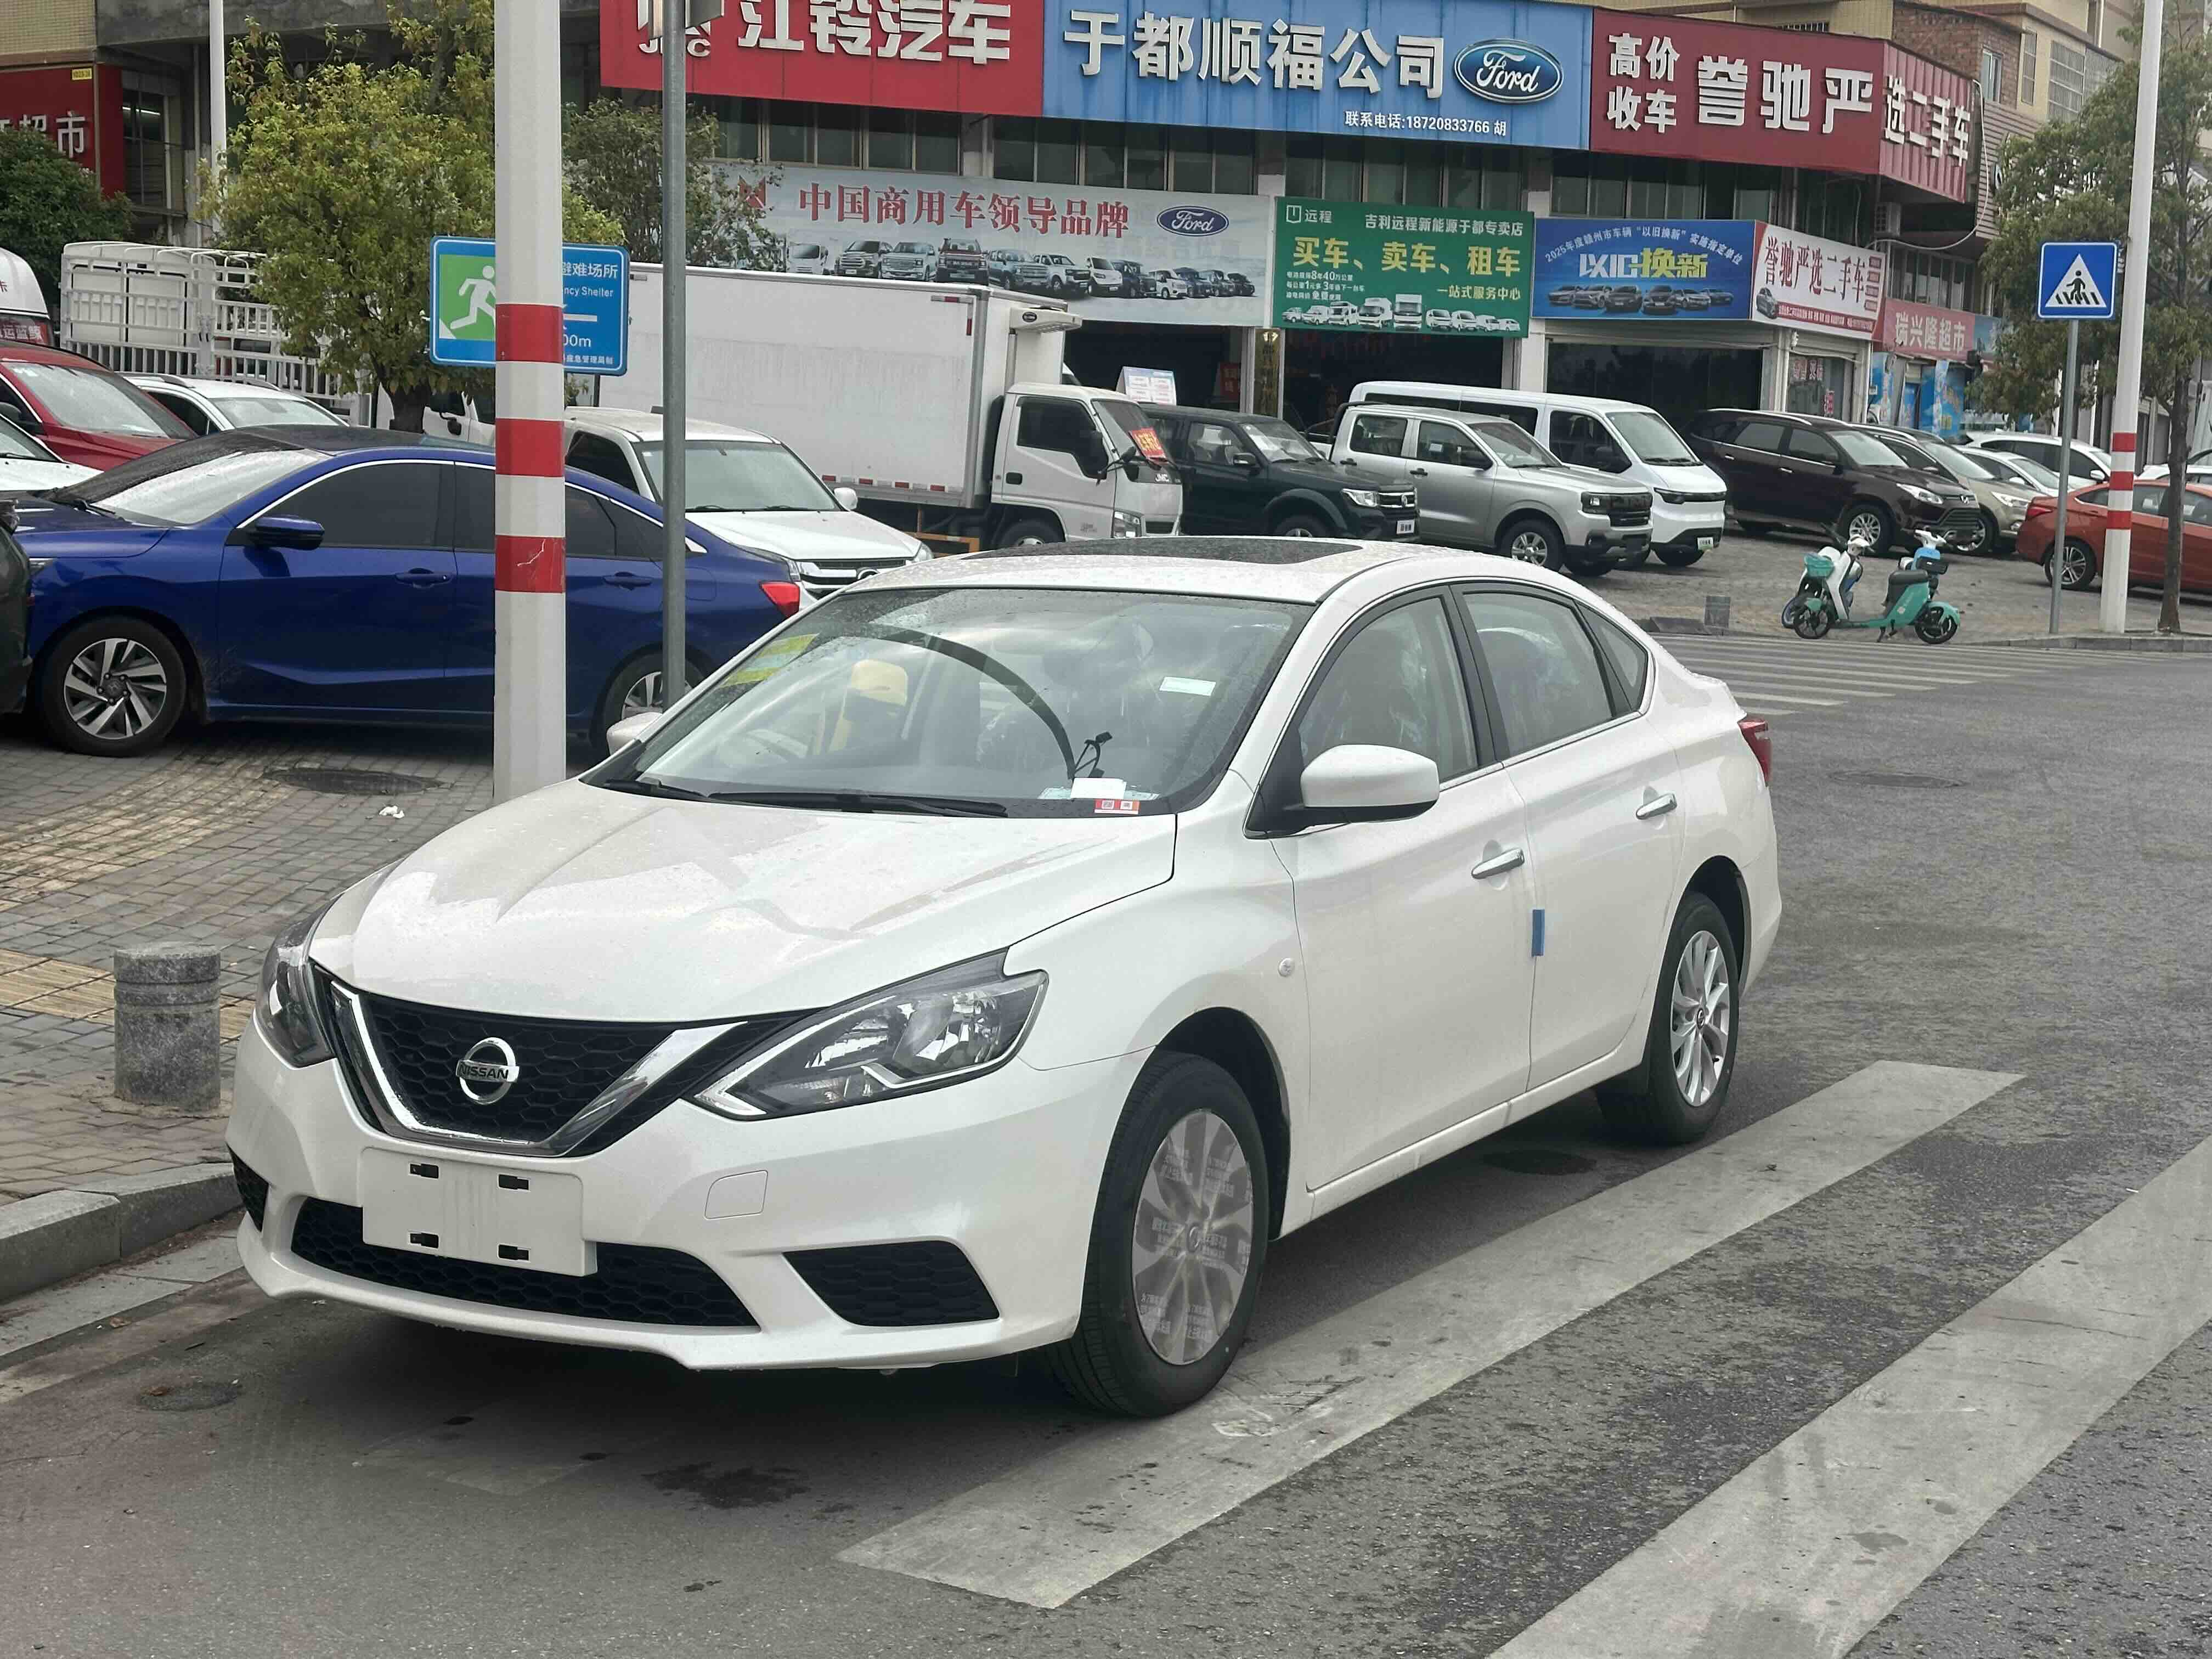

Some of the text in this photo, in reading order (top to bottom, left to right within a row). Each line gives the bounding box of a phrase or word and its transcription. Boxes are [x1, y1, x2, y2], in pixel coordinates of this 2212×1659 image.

[638, 37, 710, 57] JC
[738, 0, 1011, 64] 江铃汽车
[1064, 9, 1445, 99] 于都顺福公司
[1609, 32, 1680, 81] 高价
[1345, 110, 1507, 137] 联系电话:18720833766 胡
[1607, 86, 1677, 134] 收车
[1883, 75, 1971, 167] 选二手车
[799, 182, 1129, 238] 中国商用车领导品牌
[1304, 209, 1332, 224] 远程
[1365, 213, 1523, 236] 吉利远程新能源于都专卖店
[1293, 236, 1521, 277] 买车、卖车、租车
[1579, 247, 1708, 278] 以旧换新
[1764, 236, 1865, 303] 誉驰严选二手车
[1436, 284, 1522, 300] 一站式服务中心
[1894, 311, 1966, 355] 瑞兴隆超市
[459, 1064, 509, 1079] NISSAN
